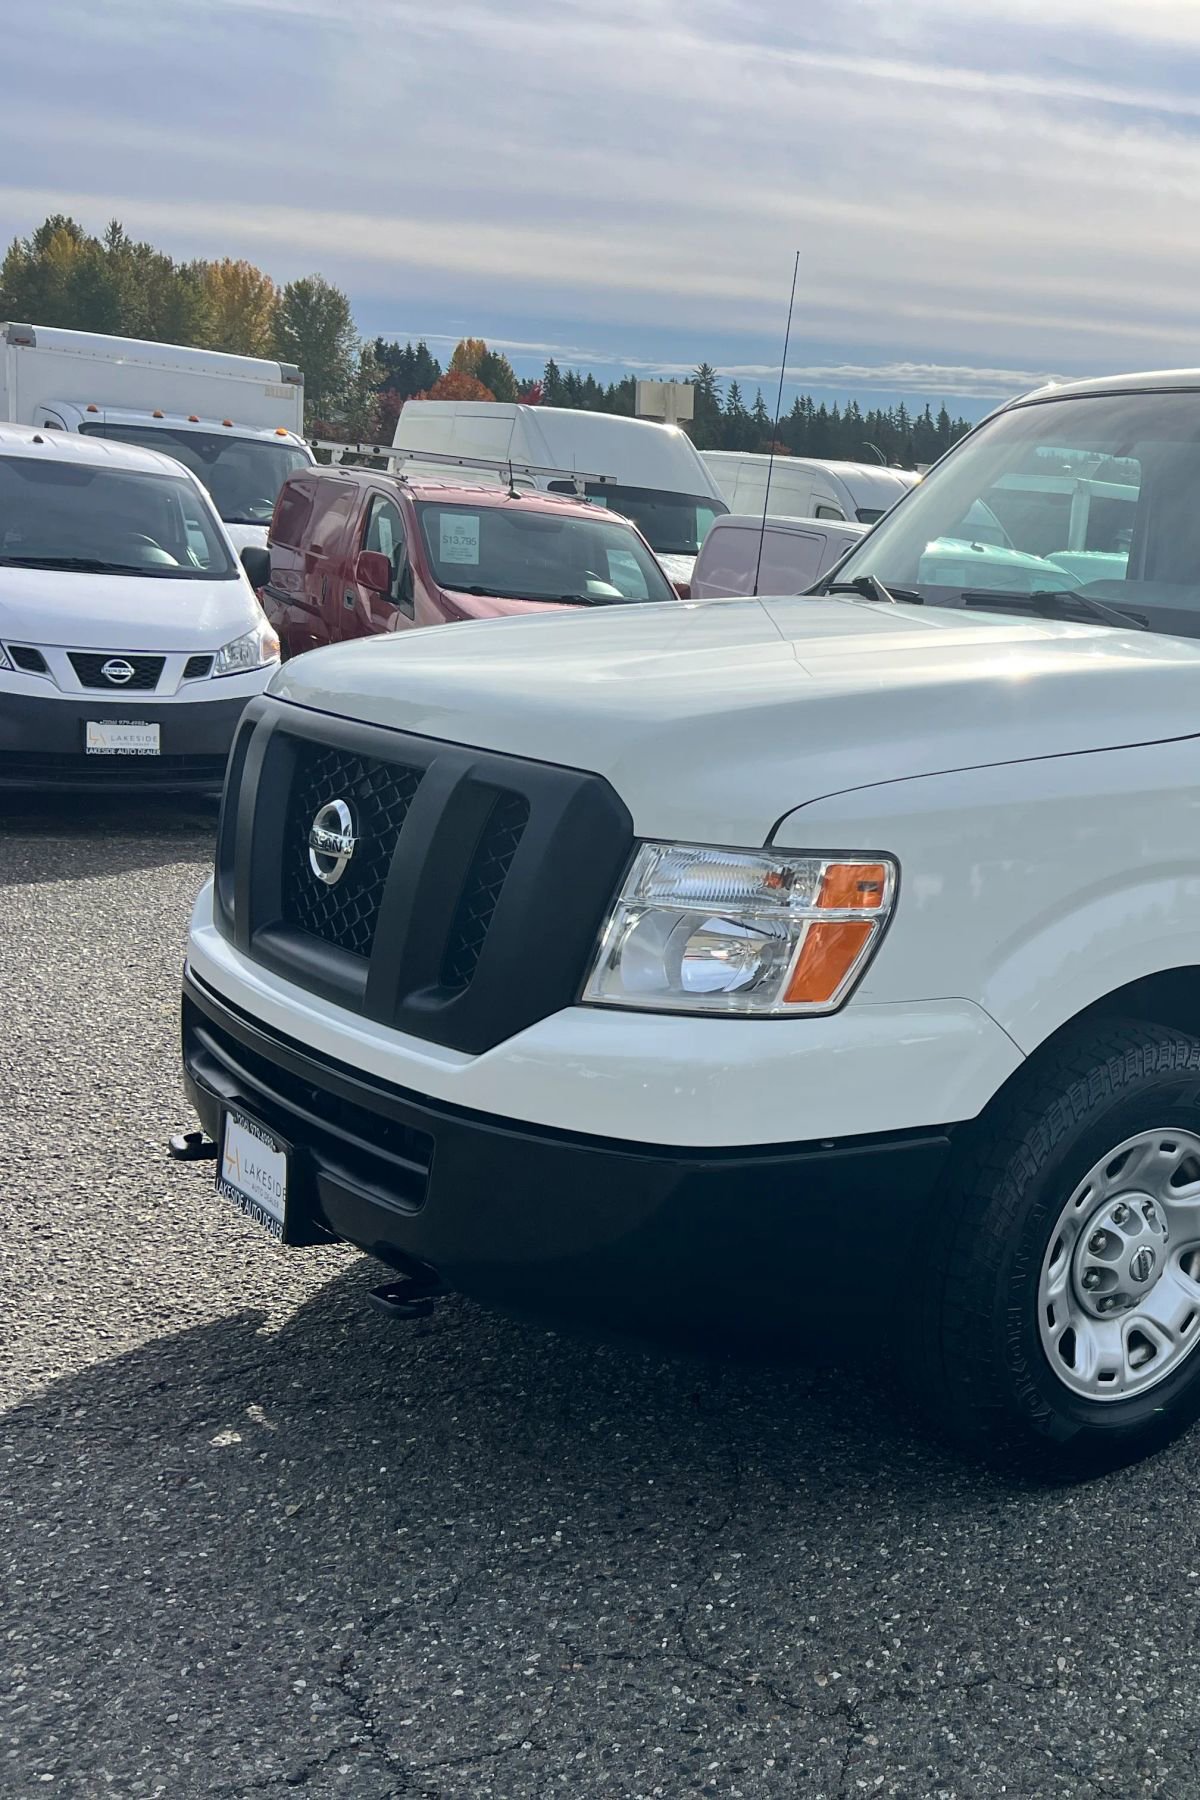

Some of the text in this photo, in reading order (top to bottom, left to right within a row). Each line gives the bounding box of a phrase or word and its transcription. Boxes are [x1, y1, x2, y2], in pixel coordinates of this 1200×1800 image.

[216, 1178, 244, 1208] LAKESIDE
[244, 1199, 262, 1223] AUTO
[244, 1159, 286, 1202] LAKESIDE
